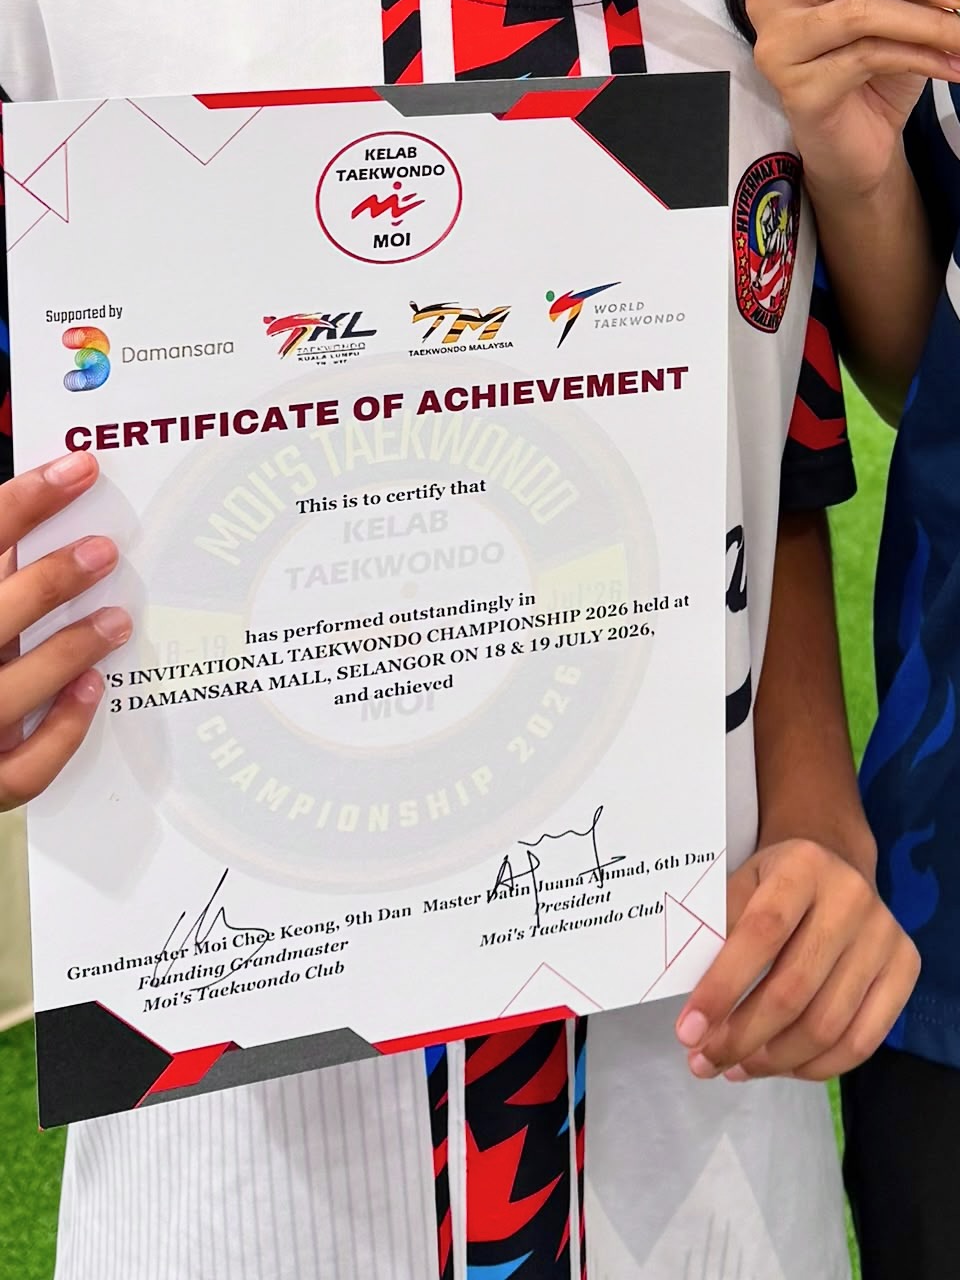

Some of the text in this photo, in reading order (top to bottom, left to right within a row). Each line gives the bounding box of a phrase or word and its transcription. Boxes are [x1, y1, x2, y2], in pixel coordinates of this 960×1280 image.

[336, 164, 445, 182] TAEKWONDO
[364, 146, 417, 161] KELAB
[736, 158, 776, 233] HYPERMAX
[373, 232, 411, 249] MOI
[46, 304, 123, 324] Supported by
[594, 312, 686, 329] TAEKWONDO
[595, 301, 645, 315] WORLD
[122, 341, 234, 364] Damansara
[408, 341, 514, 358] TAEKWONDO MALAYSIA
[65, 366, 689, 453] CERTIFICATE OF ACHIEVEMENT
[195, 411, 582, 566] MOI'S TAEKWONDO
[296, 479, 487, 515] This is to certify that
[343, 509, 449, 544] KELAB
[284, 541, 505, 592] TAEKWONDO
[129, 652, 284, 686] INVITATIONAL
[288, 631, 422, 663] TAEKWONDO
[427, 609, 582, 643] CHAMPIONSHIP
[585, 602, 629, 621] 2026
[632, 597, 669, 615] held
[674, 595, 690, 609] at
[245, 591, 536, 645] has performed outstandingly in
[110, 622, 656, 714] 3 DAMANSARA MALL, SELANGOR ON 18 & 19 JULY 2026,
[333, 674, 454, 706] and achieved
[196, 715, 494, 834] CHAMPIONSHIP
[423, 893, 482, 914] Master
[535, 874, 584, 893] Juana
[588, 861, 650, 884] Ahmad,
[654, 856, 680, 870] 6th
[684, 851, 716, 867] Dan
[535, 890, 612, 915] President
[66, 906, 412, 982] Grandmaster Moi Chee Keong, 9th Dan
[479, 900, 665, 948] Moi's Taekwondo Club
[137, 938, 349, 991] Founding Grandmaster
[142, 960, 346, 1014] Moi's Taekwondo Club
